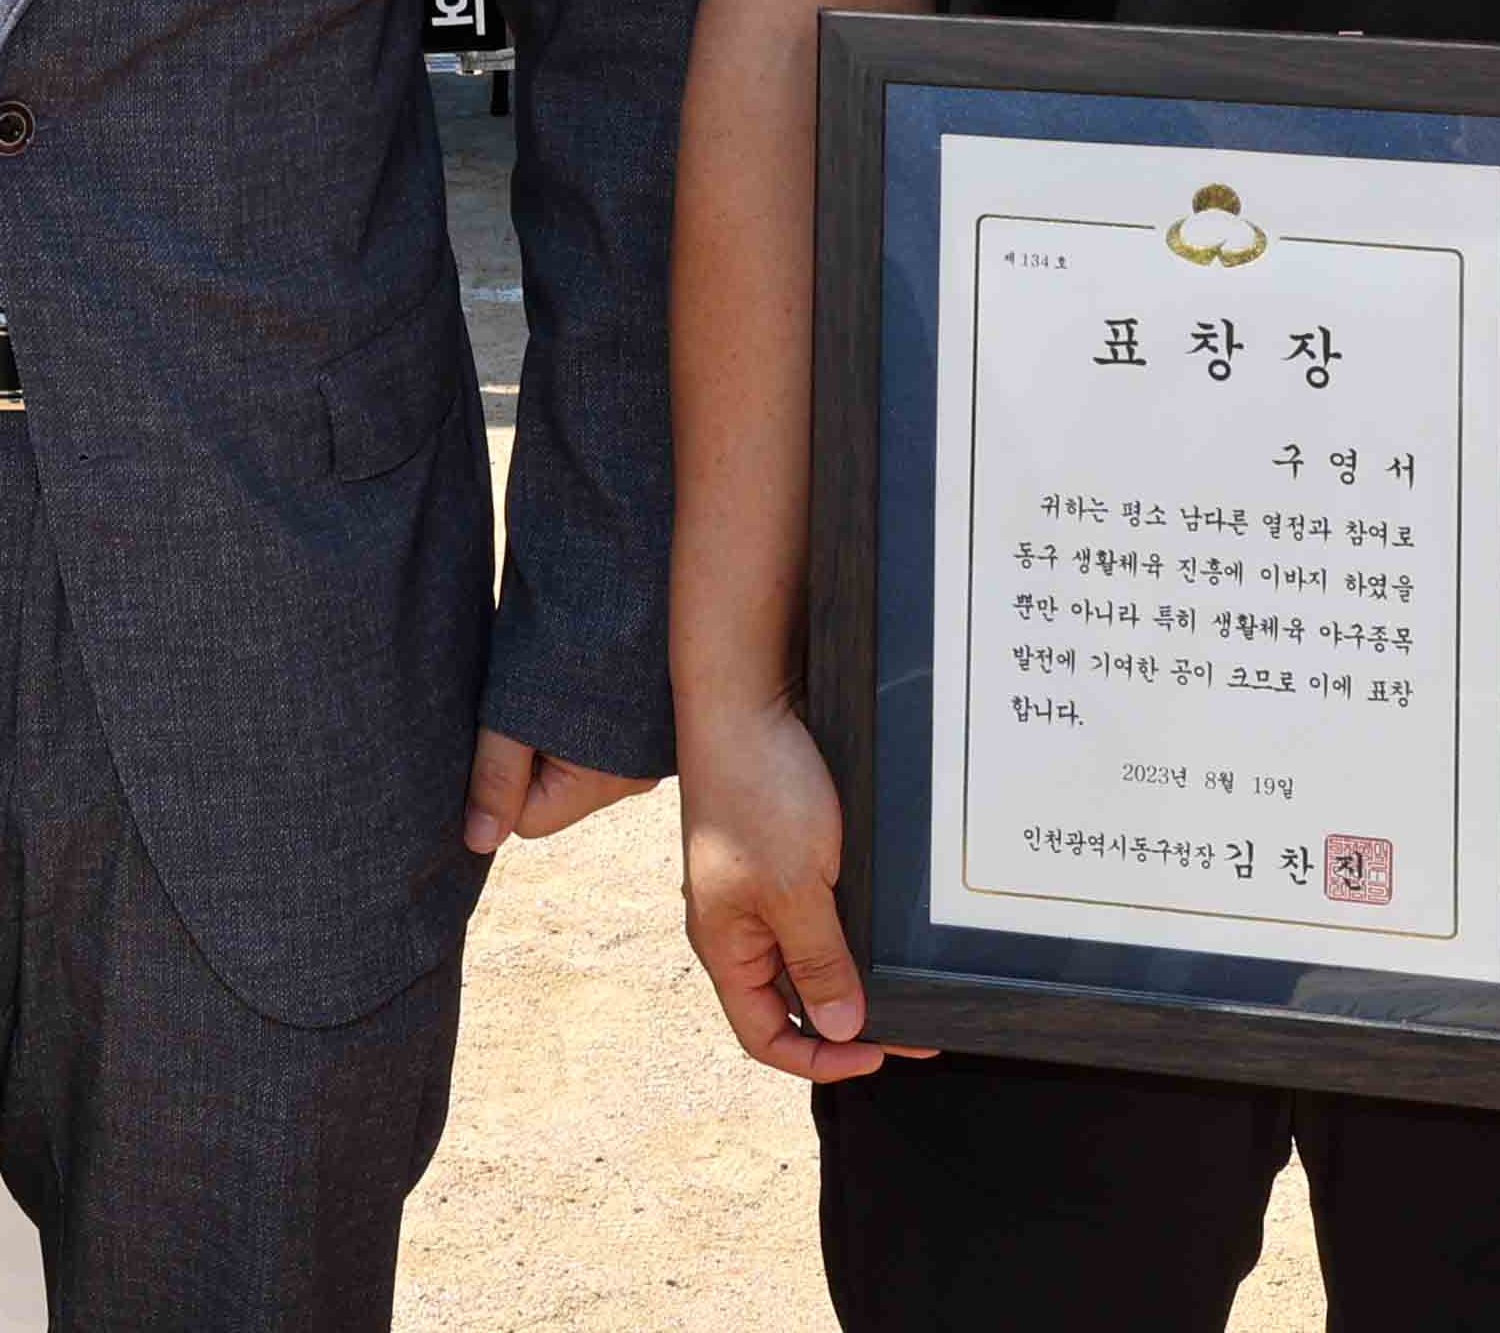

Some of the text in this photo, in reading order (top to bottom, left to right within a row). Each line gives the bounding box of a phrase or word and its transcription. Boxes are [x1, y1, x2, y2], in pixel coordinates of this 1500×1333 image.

[1039, 492, 1415, 548] 귀하는 평소 남다른 열정과 참여로
[1012, 541, 1415, 604] 동구 생활체육 진흥에 이바지 하였을
[1012, 592, 1414, 656] 뿐만 아니라 특히 생활체육 야구종목
[1012, 644, 1414, 709] 발전에 기여한 공이 크므로 이에 표창
[1011, 695, 1084, 726] 합니다.
[1122, 763, 1294, 801] 2023년 8월 19일
[1023, 825, 1216, 870] 인천광역시동구청장
